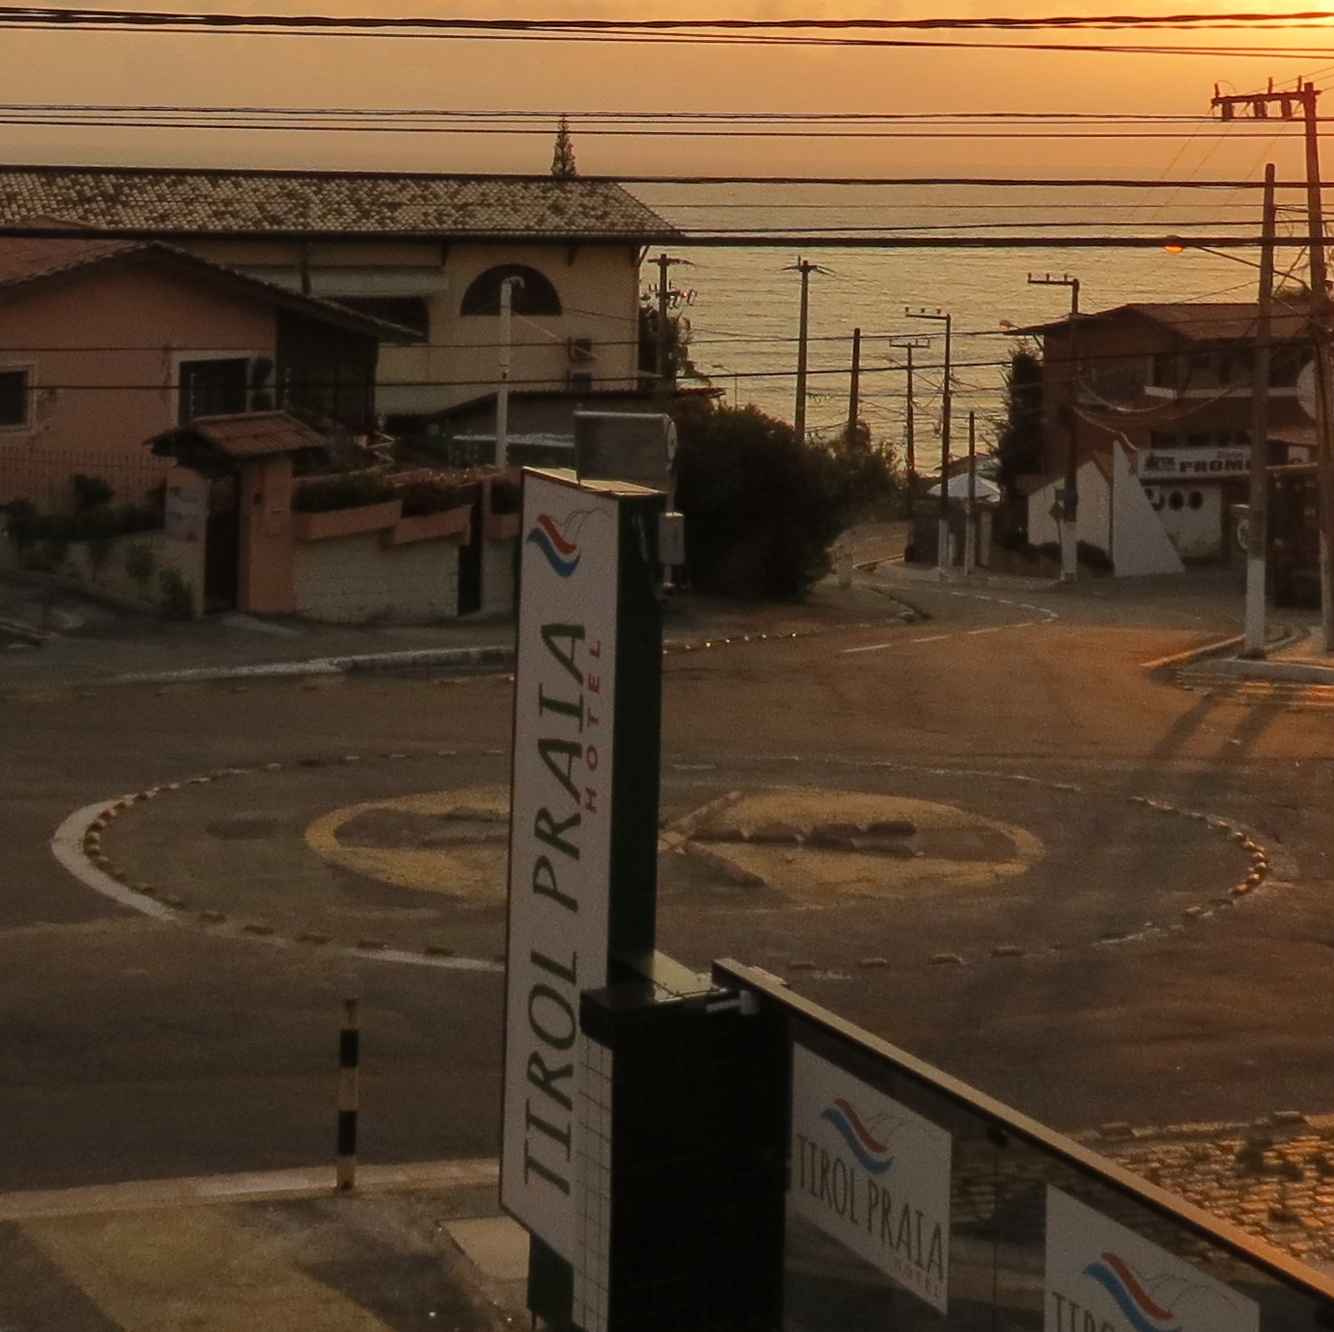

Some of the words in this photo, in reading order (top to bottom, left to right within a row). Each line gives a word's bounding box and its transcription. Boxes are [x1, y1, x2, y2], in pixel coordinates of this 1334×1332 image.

[532, 624, 585, 914] PRAIA
[584, 639, 602, 814] HOTEL
[523, 950, 578, 1197] TIROL
[797, 1133, 858, 1226] TIROL
[866, 1178, 946, 1285] PRAIA
